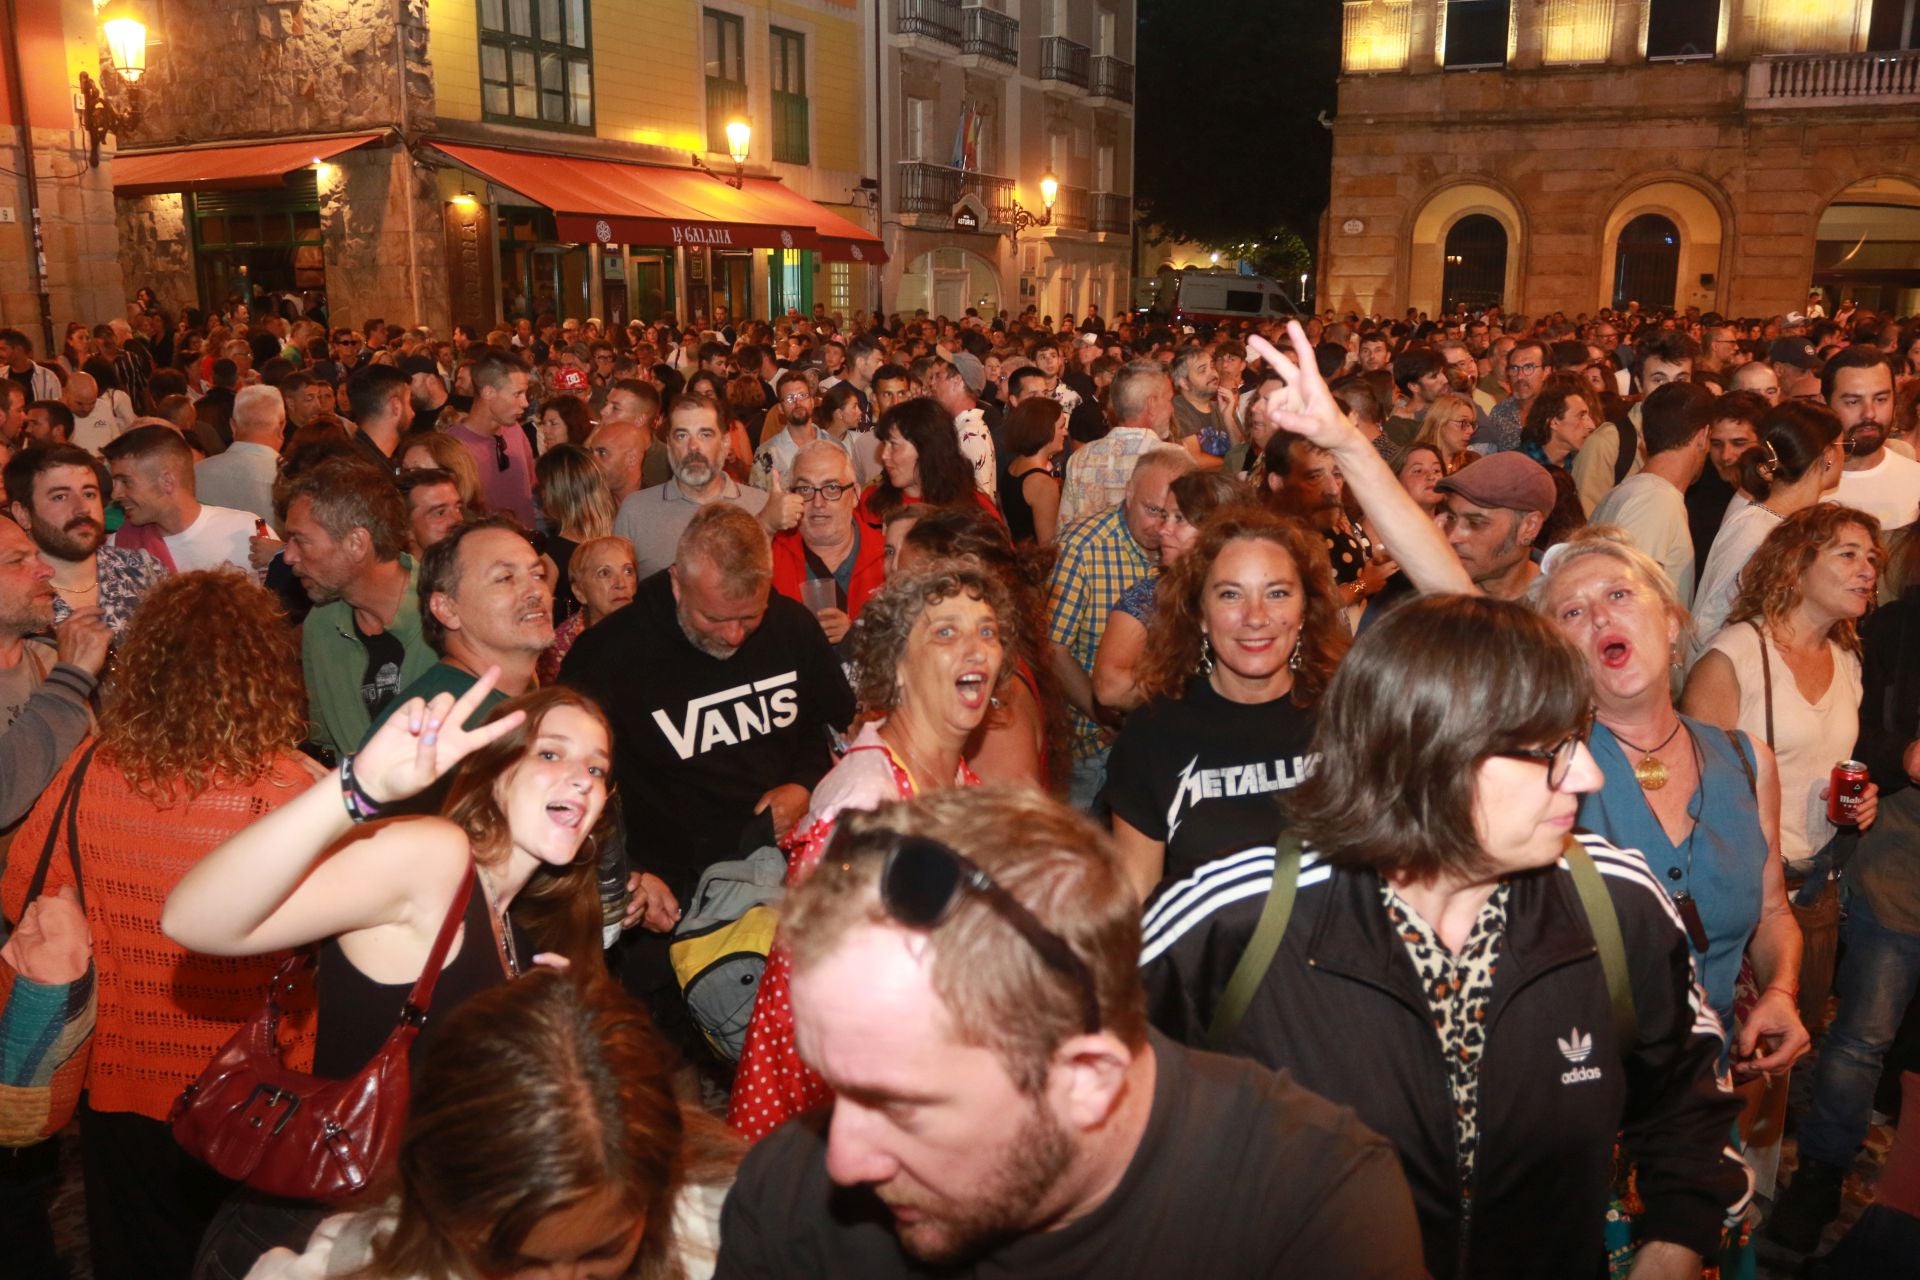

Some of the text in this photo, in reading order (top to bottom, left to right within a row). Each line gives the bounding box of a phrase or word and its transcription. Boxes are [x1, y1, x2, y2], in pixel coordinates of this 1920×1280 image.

[684, 226, 733, 244] GALANA
[651, 670, 799, 760] VANS
[1560, 1066, 1602, 1085] adidas
